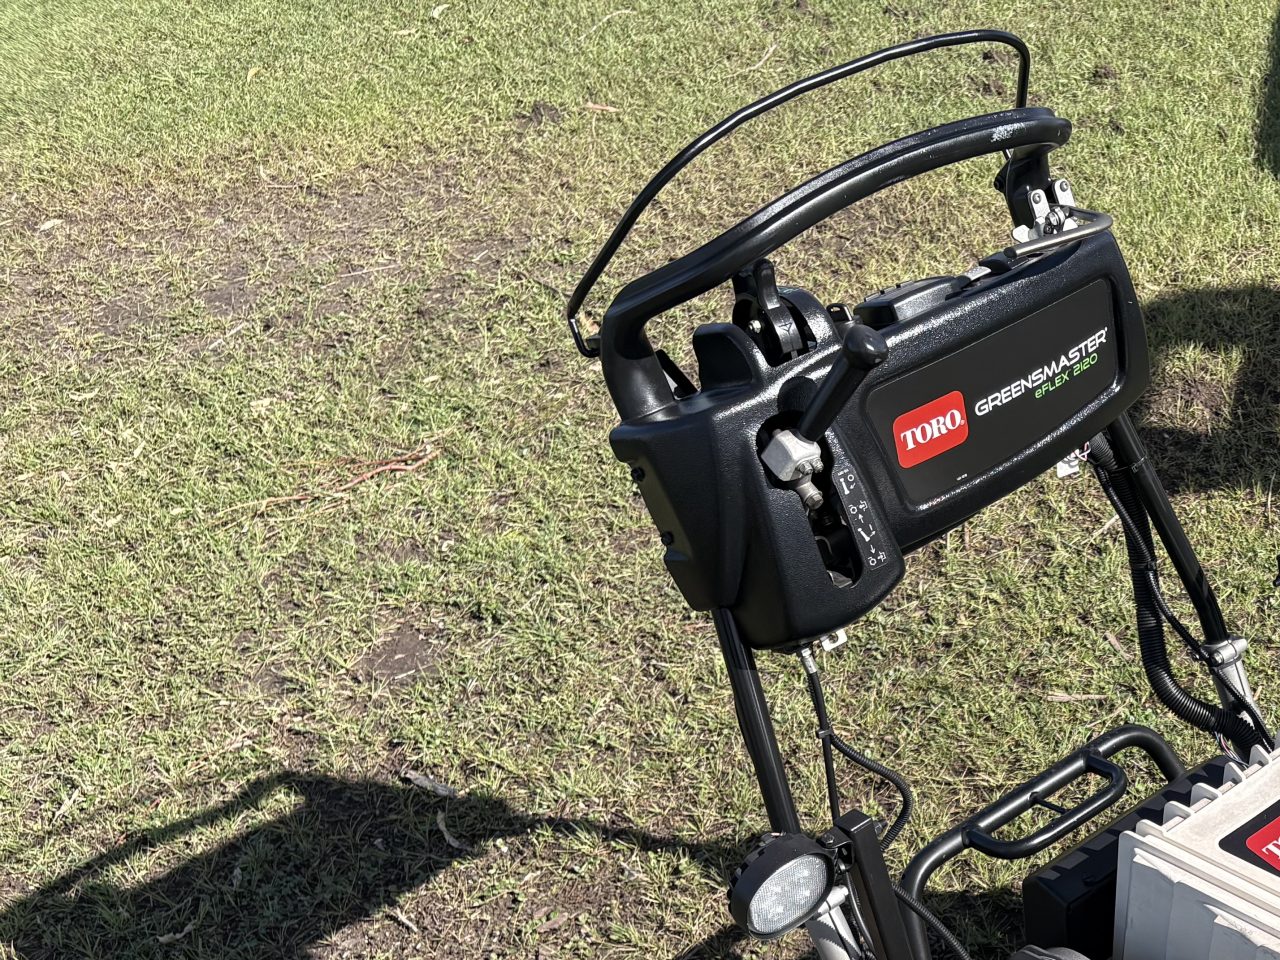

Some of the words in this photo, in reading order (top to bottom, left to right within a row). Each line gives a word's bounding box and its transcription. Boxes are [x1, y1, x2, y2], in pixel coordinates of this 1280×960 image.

[974, 327, 1107, 416] GREENSMASTER
[1035, 371, 1069, 399] eFLEX
[1073, 352, 1098, 376] 2120
[901, 409, 963, 451] TORO
